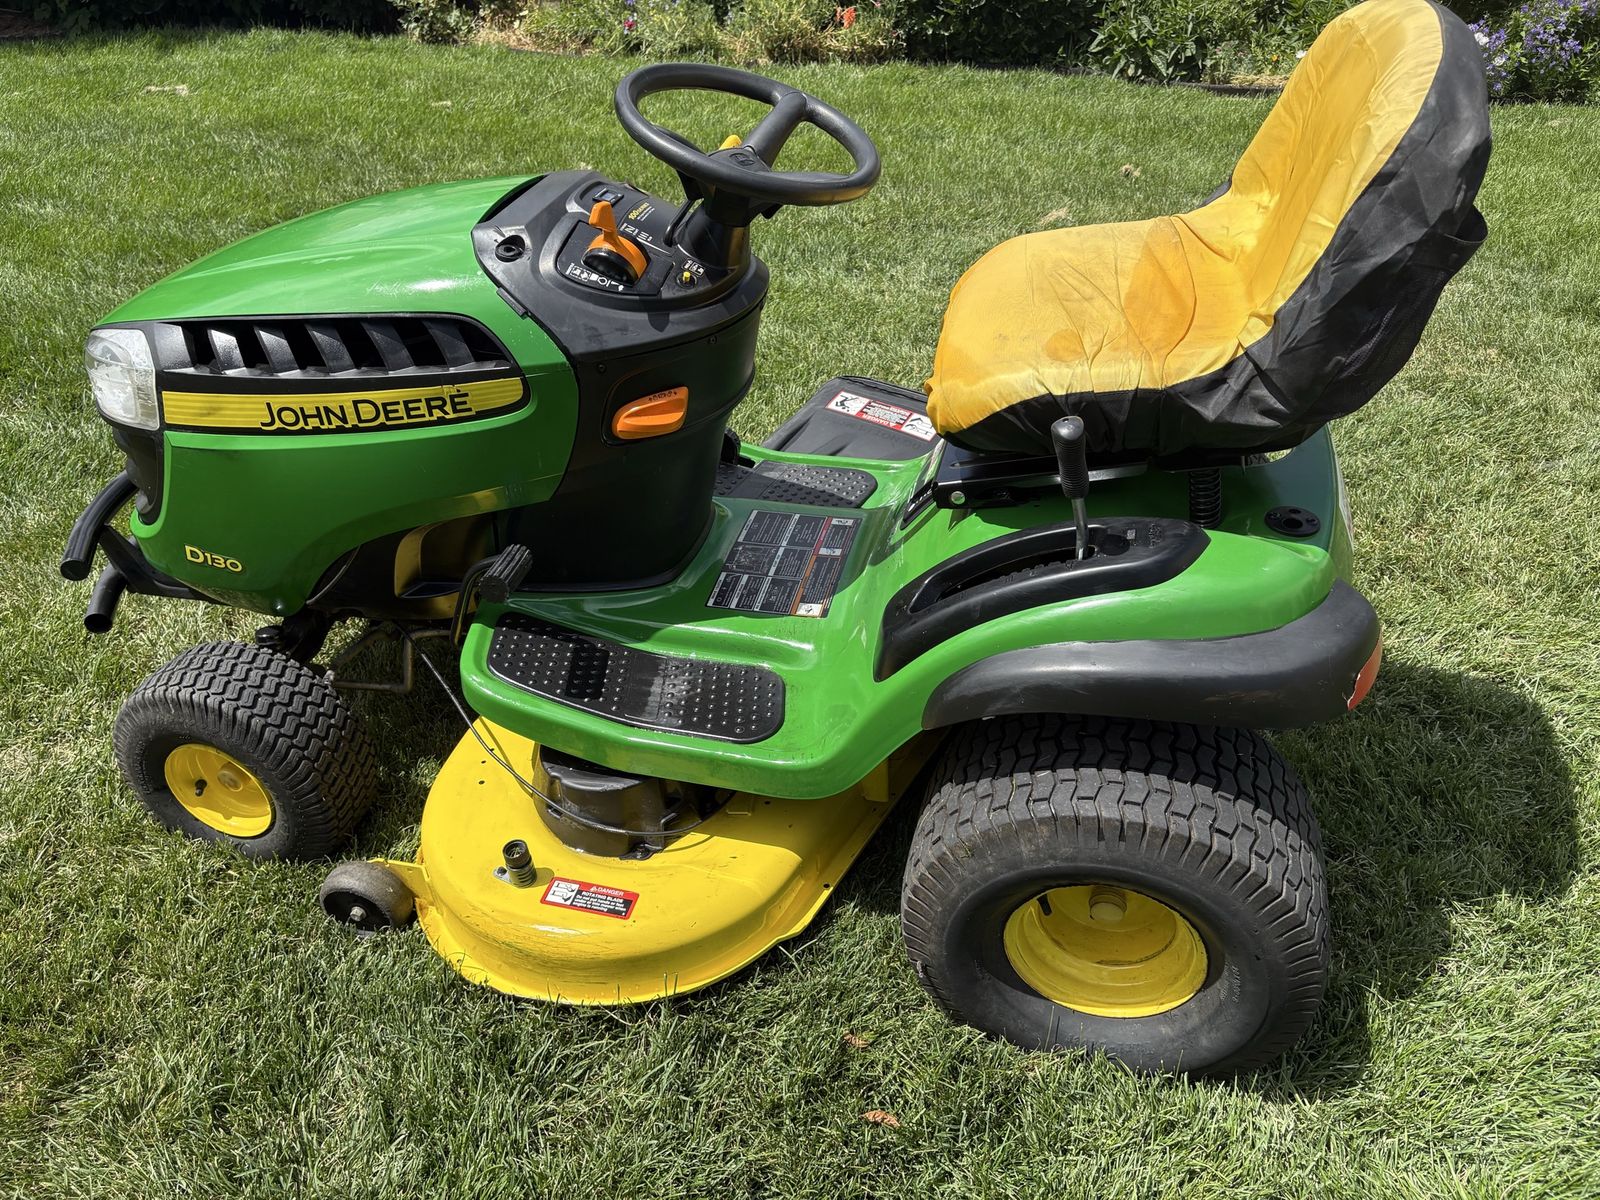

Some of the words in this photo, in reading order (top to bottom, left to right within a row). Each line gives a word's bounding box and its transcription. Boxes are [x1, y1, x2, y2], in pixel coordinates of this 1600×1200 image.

[260, 402, 349, 428] JOHN
[352, 392, 473, 424] DEERE
[185, 545, 243, 572] D130
[581, 891, 607, 900] ROTATING
[597, 886, 624, 896] DANGER
